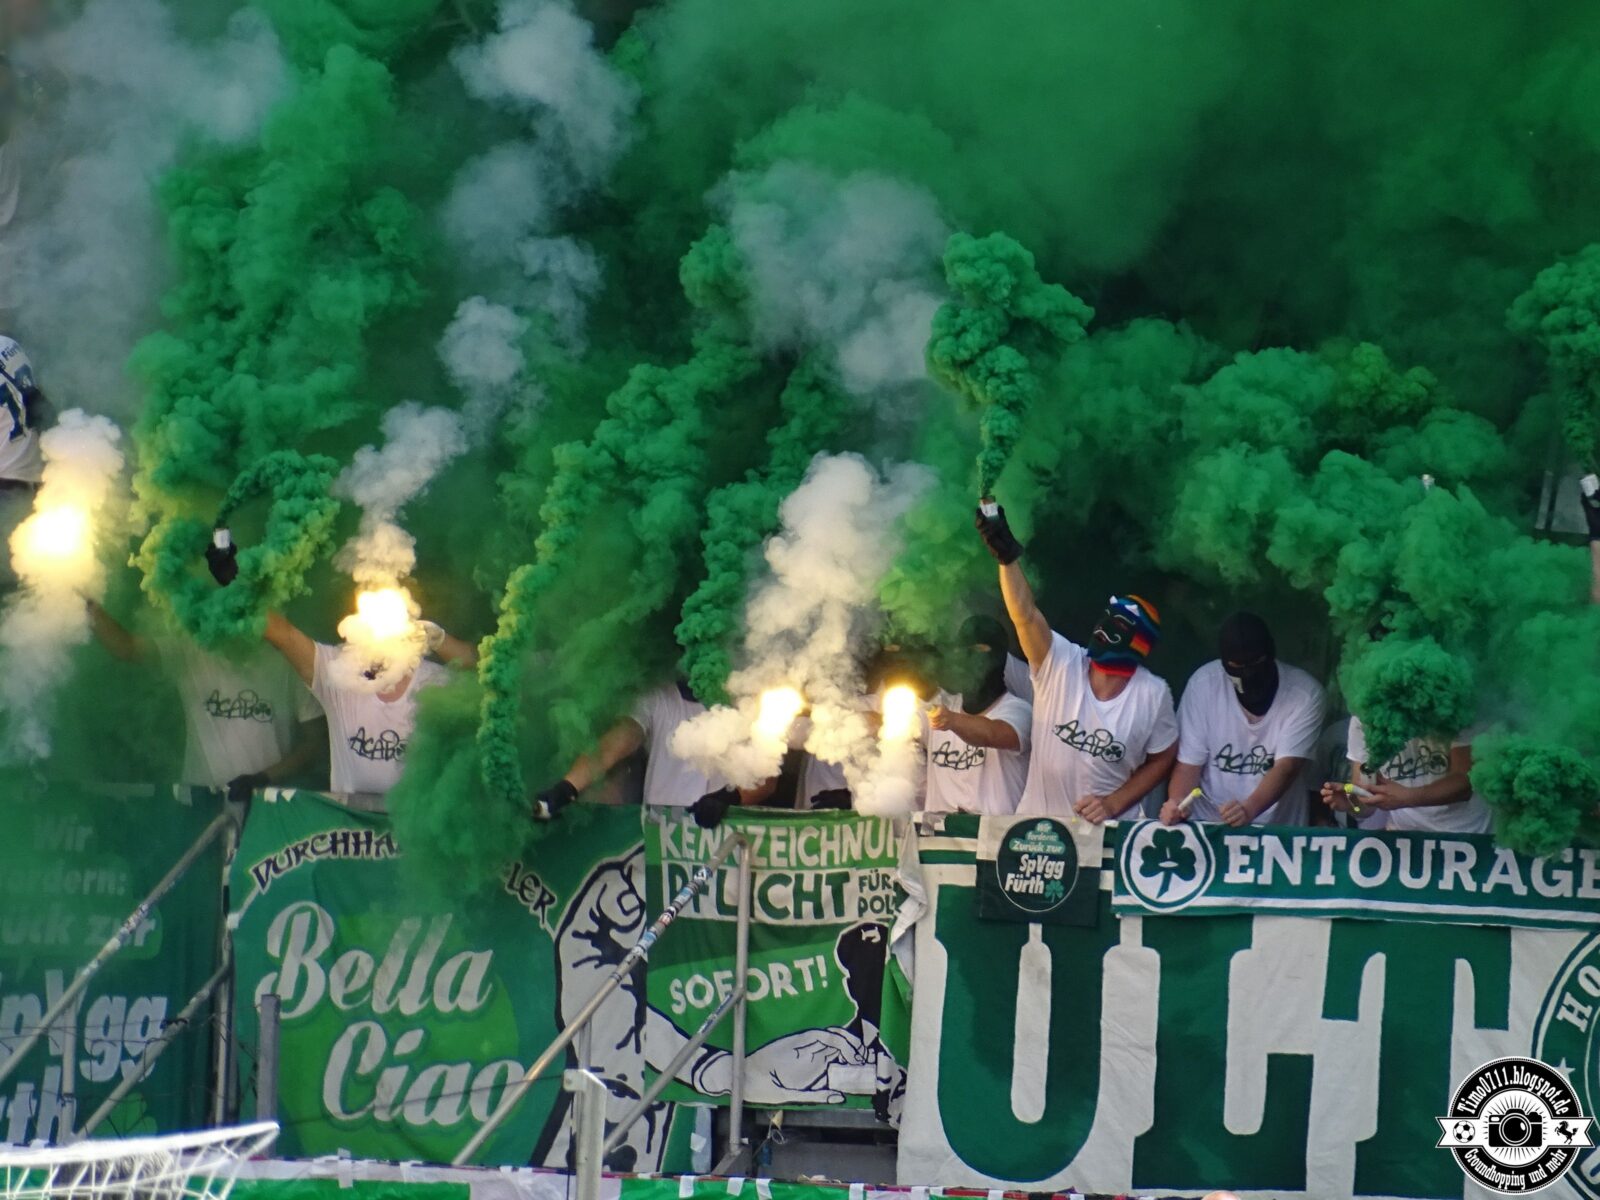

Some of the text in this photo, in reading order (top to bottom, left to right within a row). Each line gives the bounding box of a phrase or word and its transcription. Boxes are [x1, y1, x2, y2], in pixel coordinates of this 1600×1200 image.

[252, 830, 400, 890] DURCHHA
[858, 869, 892, 893] FÜR
[1004, 873, 1045, 895] Fürth
[1019, 853, 1065, 880] SpVgg
[1223, 834, 1600, 899] ENTOURAGE
[667, 863, 850, 920] PFLICHT
[255, 901, 493, 1019] Bella
[670, 955, 828, 1014] SOFORT!
[1556, 965, 1600, 1033] HO
[323, 1021, 526, 1126] Ciao
